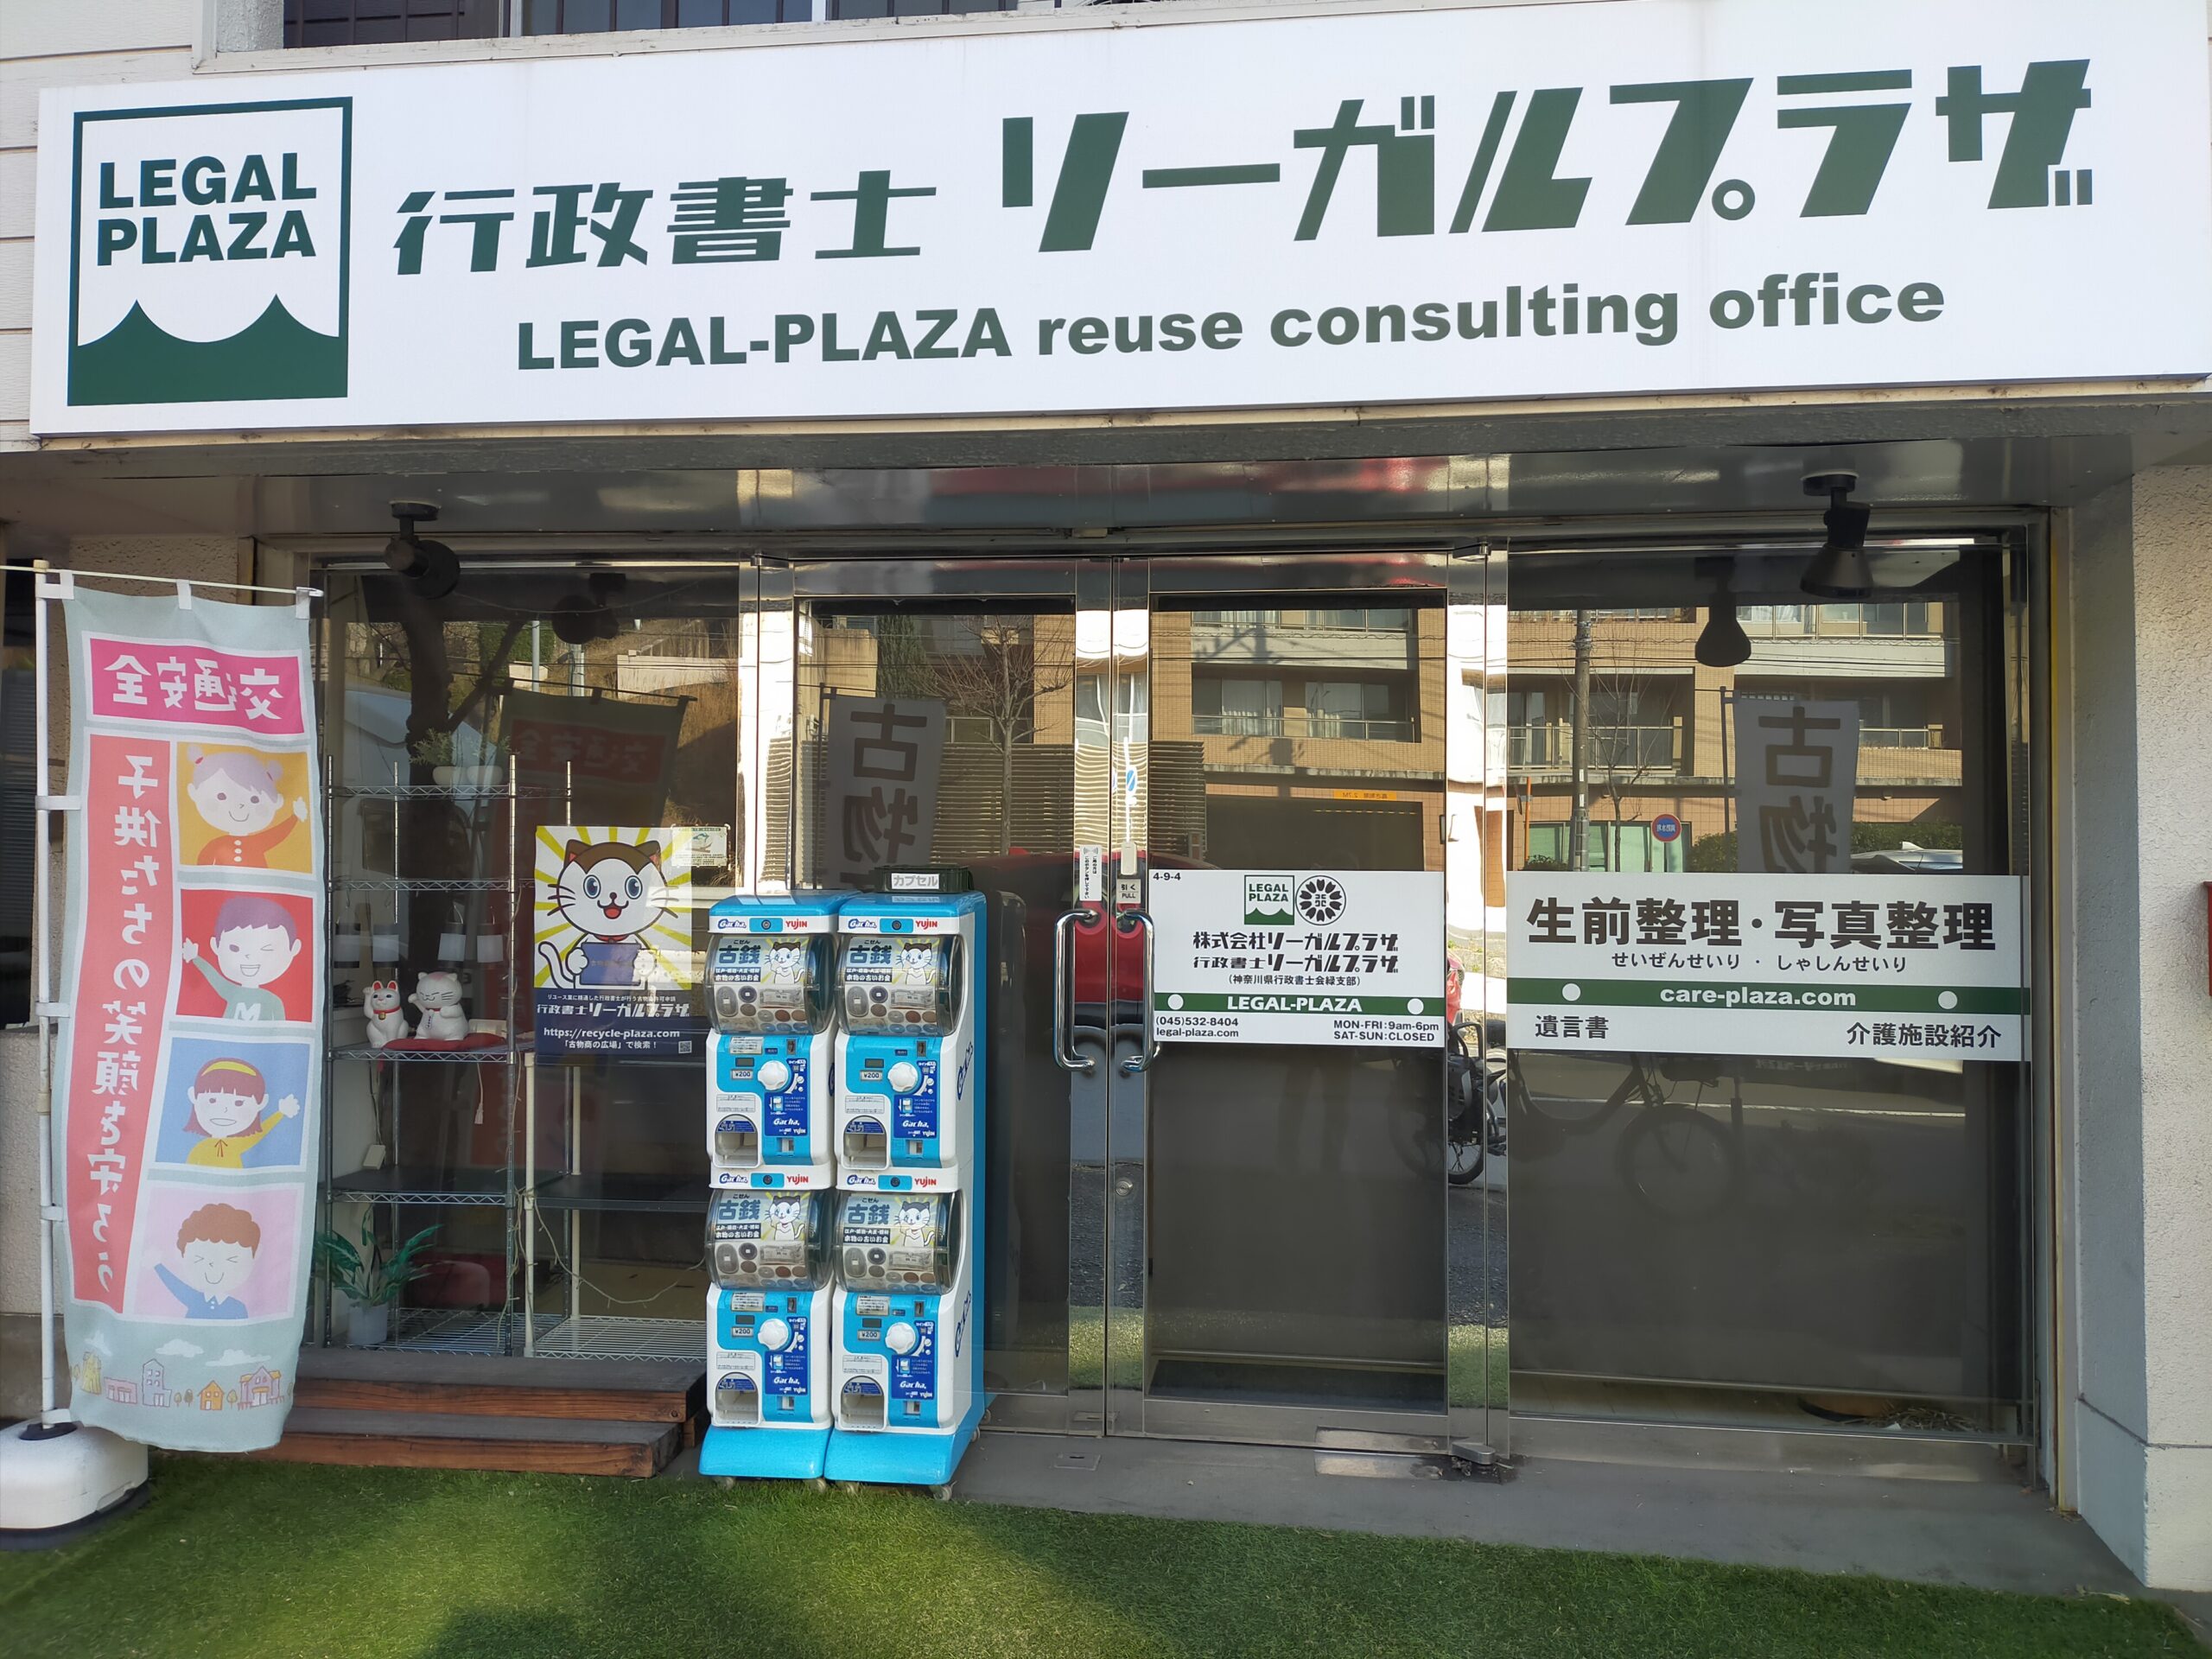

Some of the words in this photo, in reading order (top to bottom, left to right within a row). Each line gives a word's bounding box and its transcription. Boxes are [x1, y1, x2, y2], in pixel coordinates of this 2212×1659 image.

[392, 169, 938, 275] 行政書士
[1002, 59, 2093, 252] リーガルプラザ
[99, 152, 317, 208] LEGAL
[98, 210, 316, 266] PLAZA
[518, 308, 1012, 370] LEGAL-PLAZA
[1039, 311, 1243, 355] reuse
[1270, 283, 1679, 346] consulting
[1709, 272, 1945, 329] office
[1153, 873, 1181, 881] 4-9-4
[1249, 883, 1288, 893] LEGAL
[1249, 893, 1288, 902] PLAZA
[1611, 951, 1741, 970] せいぜんせいり
[1777, 954, 1908, 973] しゃしんせいり
[1227, 996, 1363, 1012] LEGAL-PLAZA
[1660, 986, 1857, 1007] care-plaza.com
[1155, 1016, 1239, 1027] (045)532-8404
[1534, 1014, 1610, 1039] 遺言書
[543, 1027, 680, 1040] https://recycle-plaza.com
[1156, 1027, 1239, 1038] legal-plaza.com
[1846, 1021, 2002, 1049] 介護施設紹介
